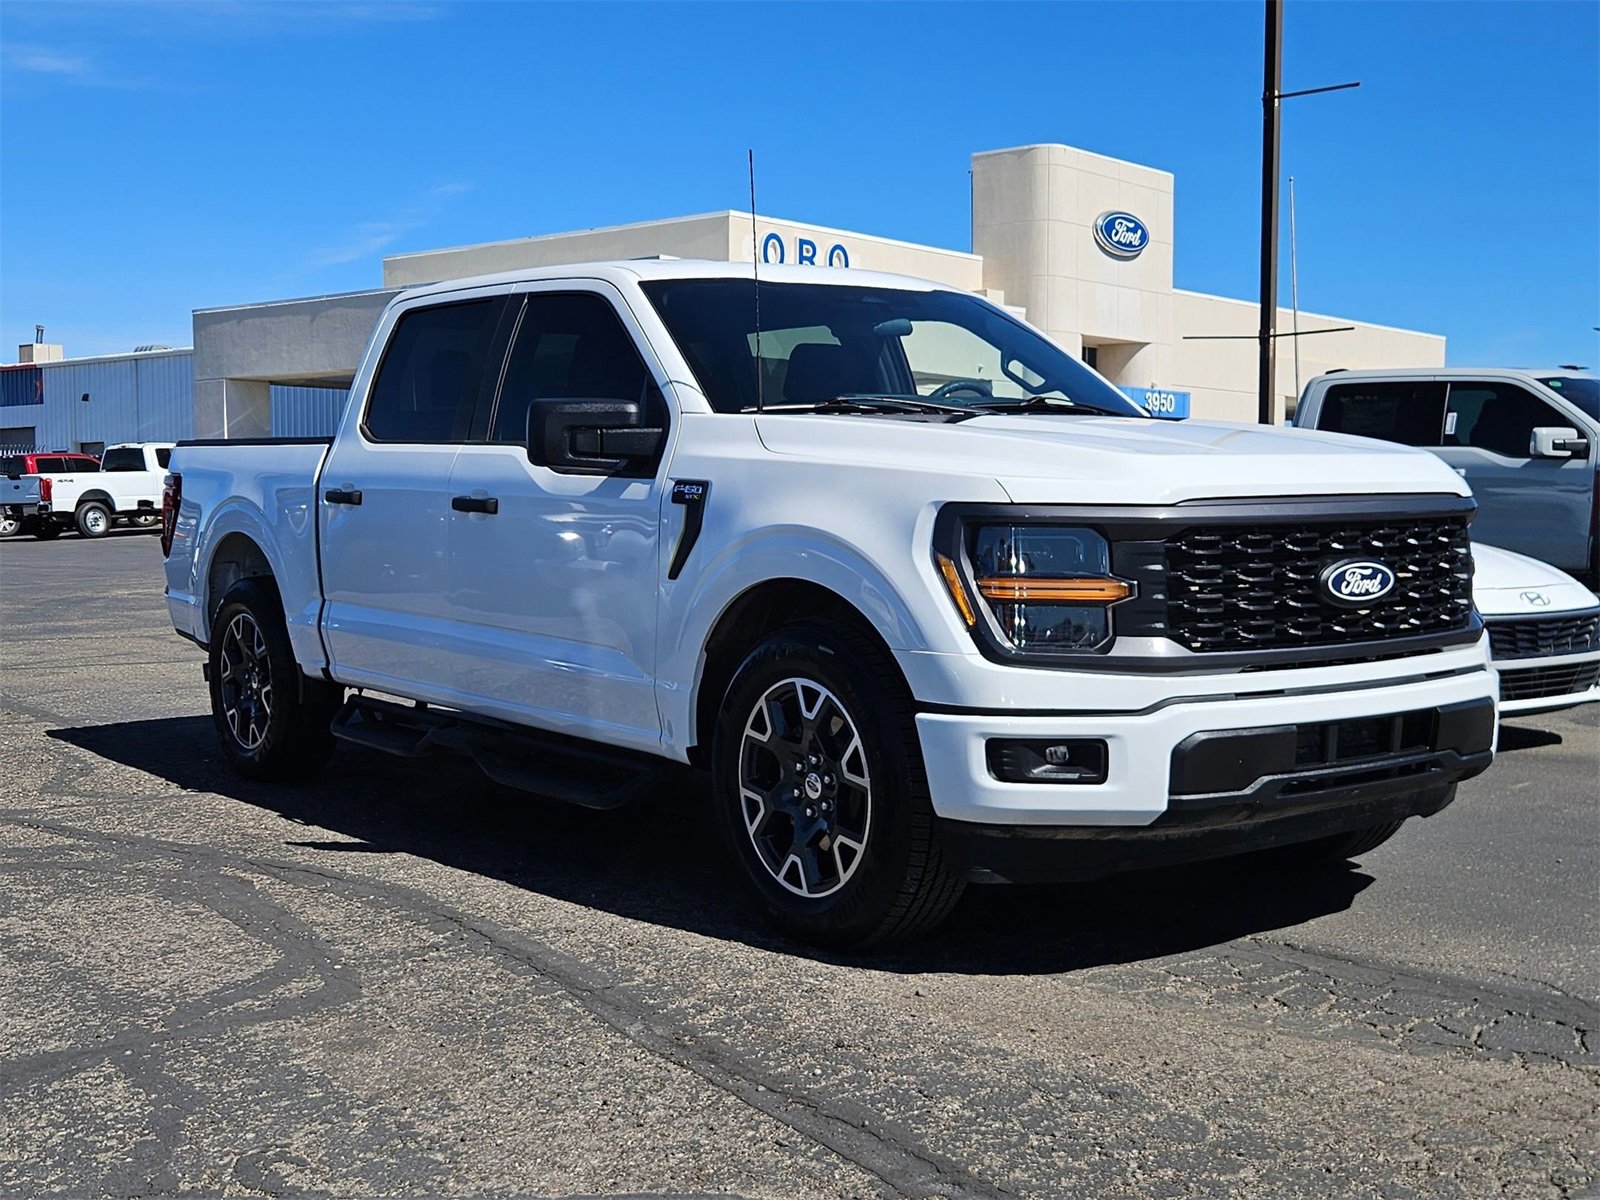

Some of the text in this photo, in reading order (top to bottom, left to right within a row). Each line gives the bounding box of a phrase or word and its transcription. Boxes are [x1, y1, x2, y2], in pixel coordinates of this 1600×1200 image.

[1111, 218, 1142, 246] Ford
[763, 232, 849, 268] ORO
[1144, 391, 1175, 413] 3950
[1341, 568, 1382, 595] Ford
